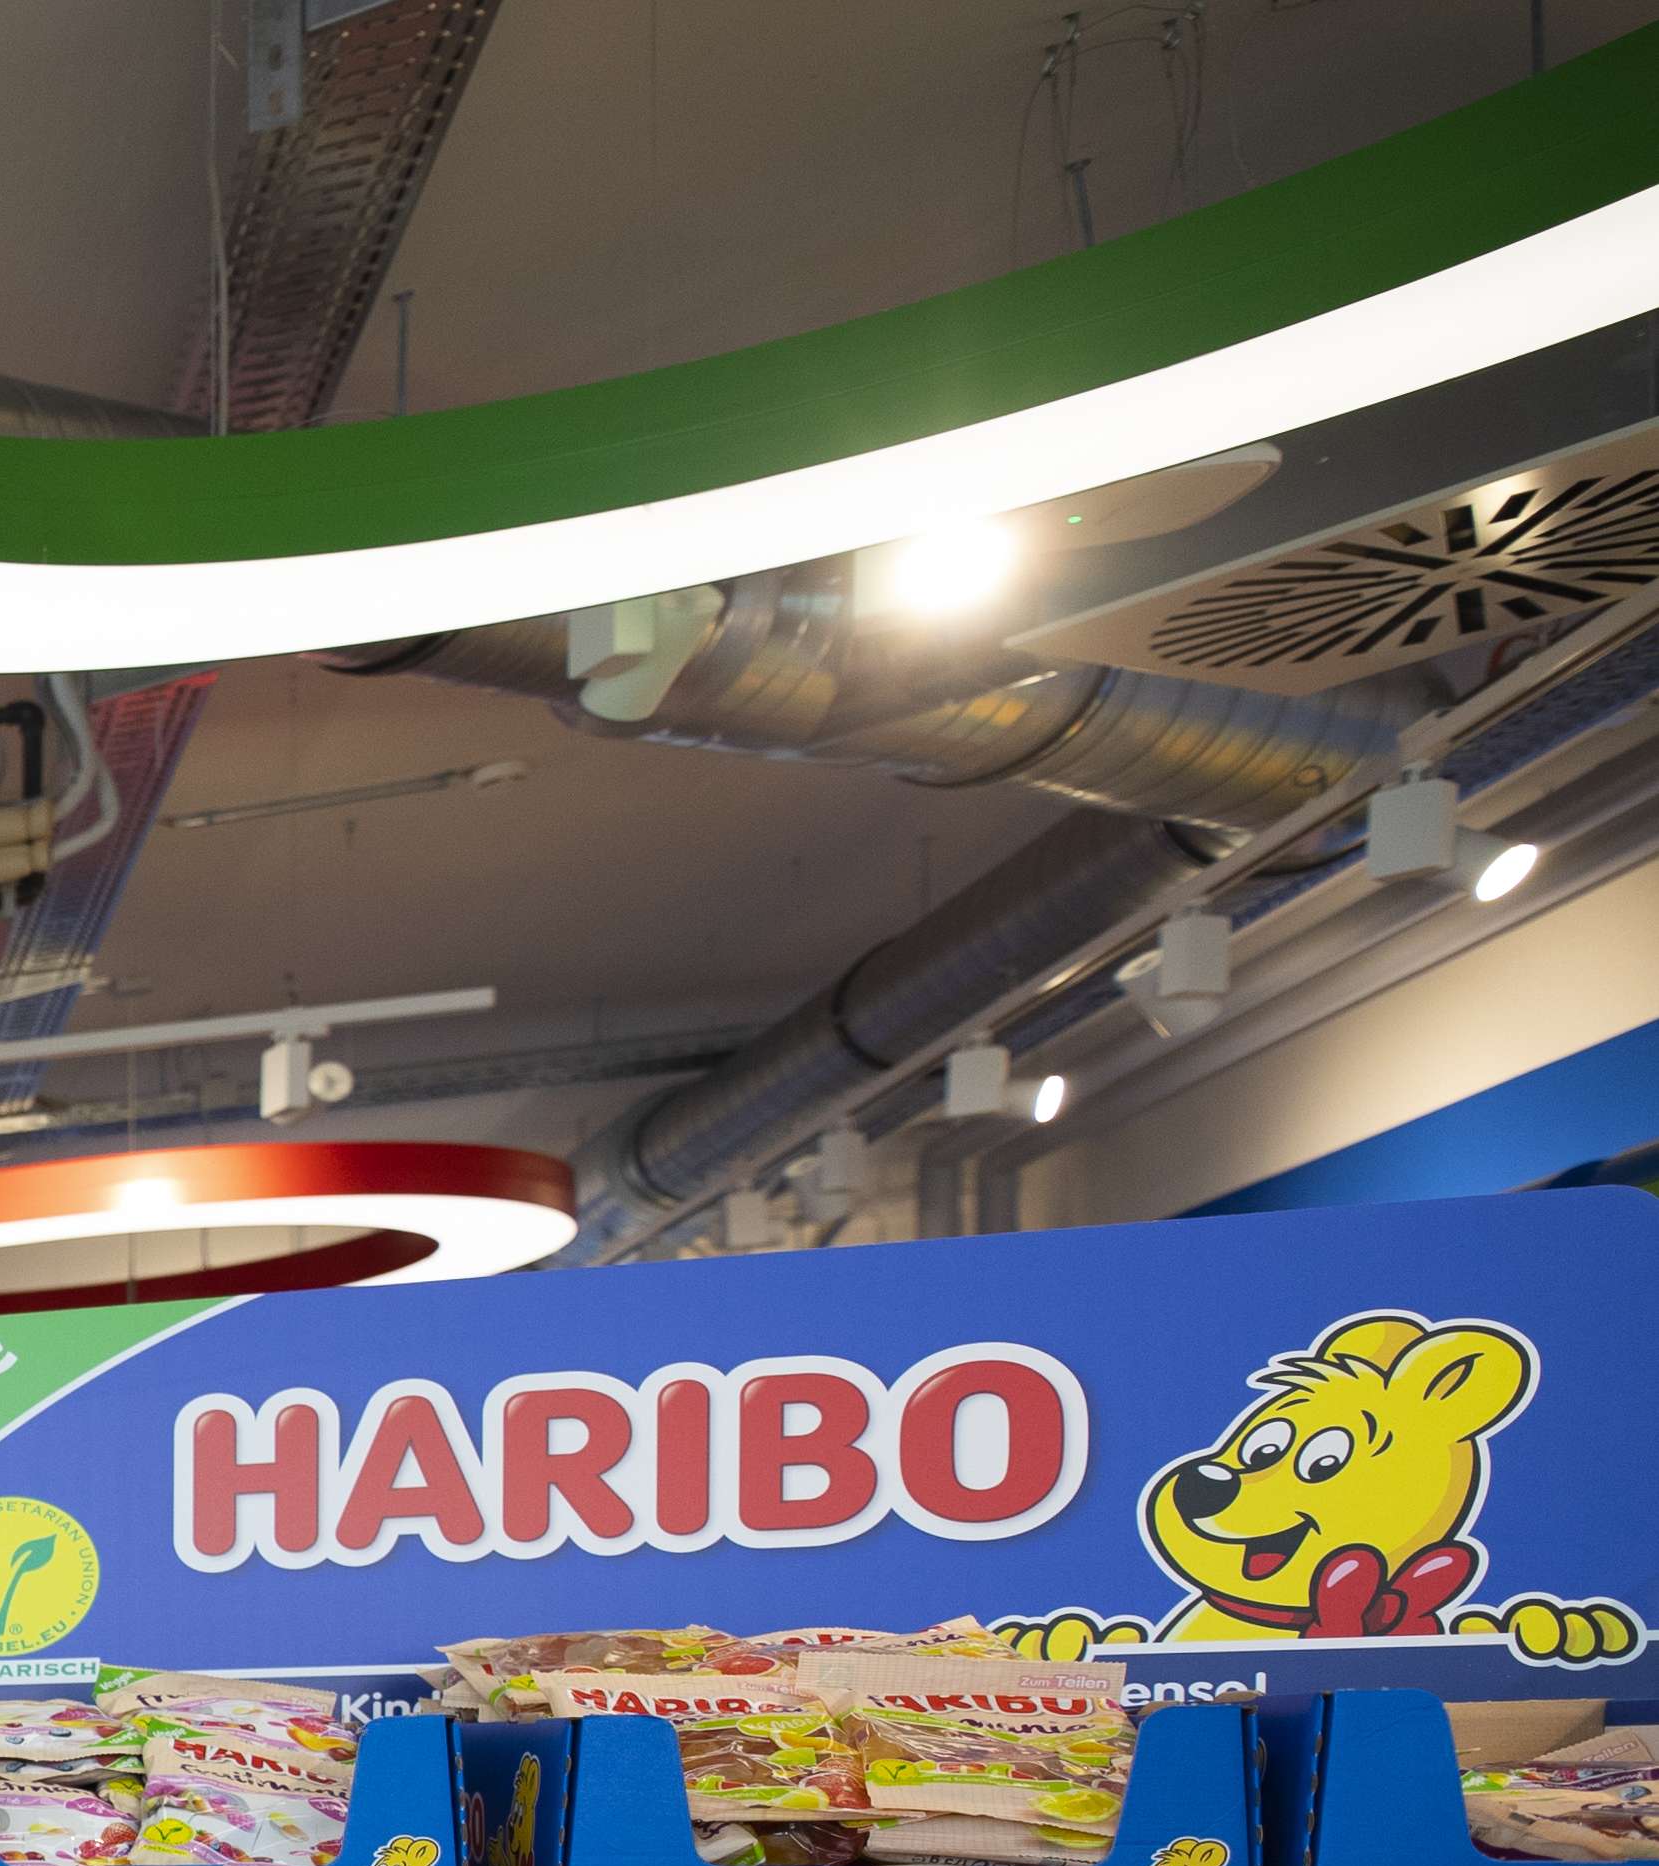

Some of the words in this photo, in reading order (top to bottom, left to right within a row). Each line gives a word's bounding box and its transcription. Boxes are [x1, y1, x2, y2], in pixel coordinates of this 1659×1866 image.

[193, 1360, 1063, 1557] HARIBO
[76, 1547, 94, 1606] UNION
[1021, 1676, 1050, 1689] Zum
[1055, 1675, 1108, 1690] Teilen
